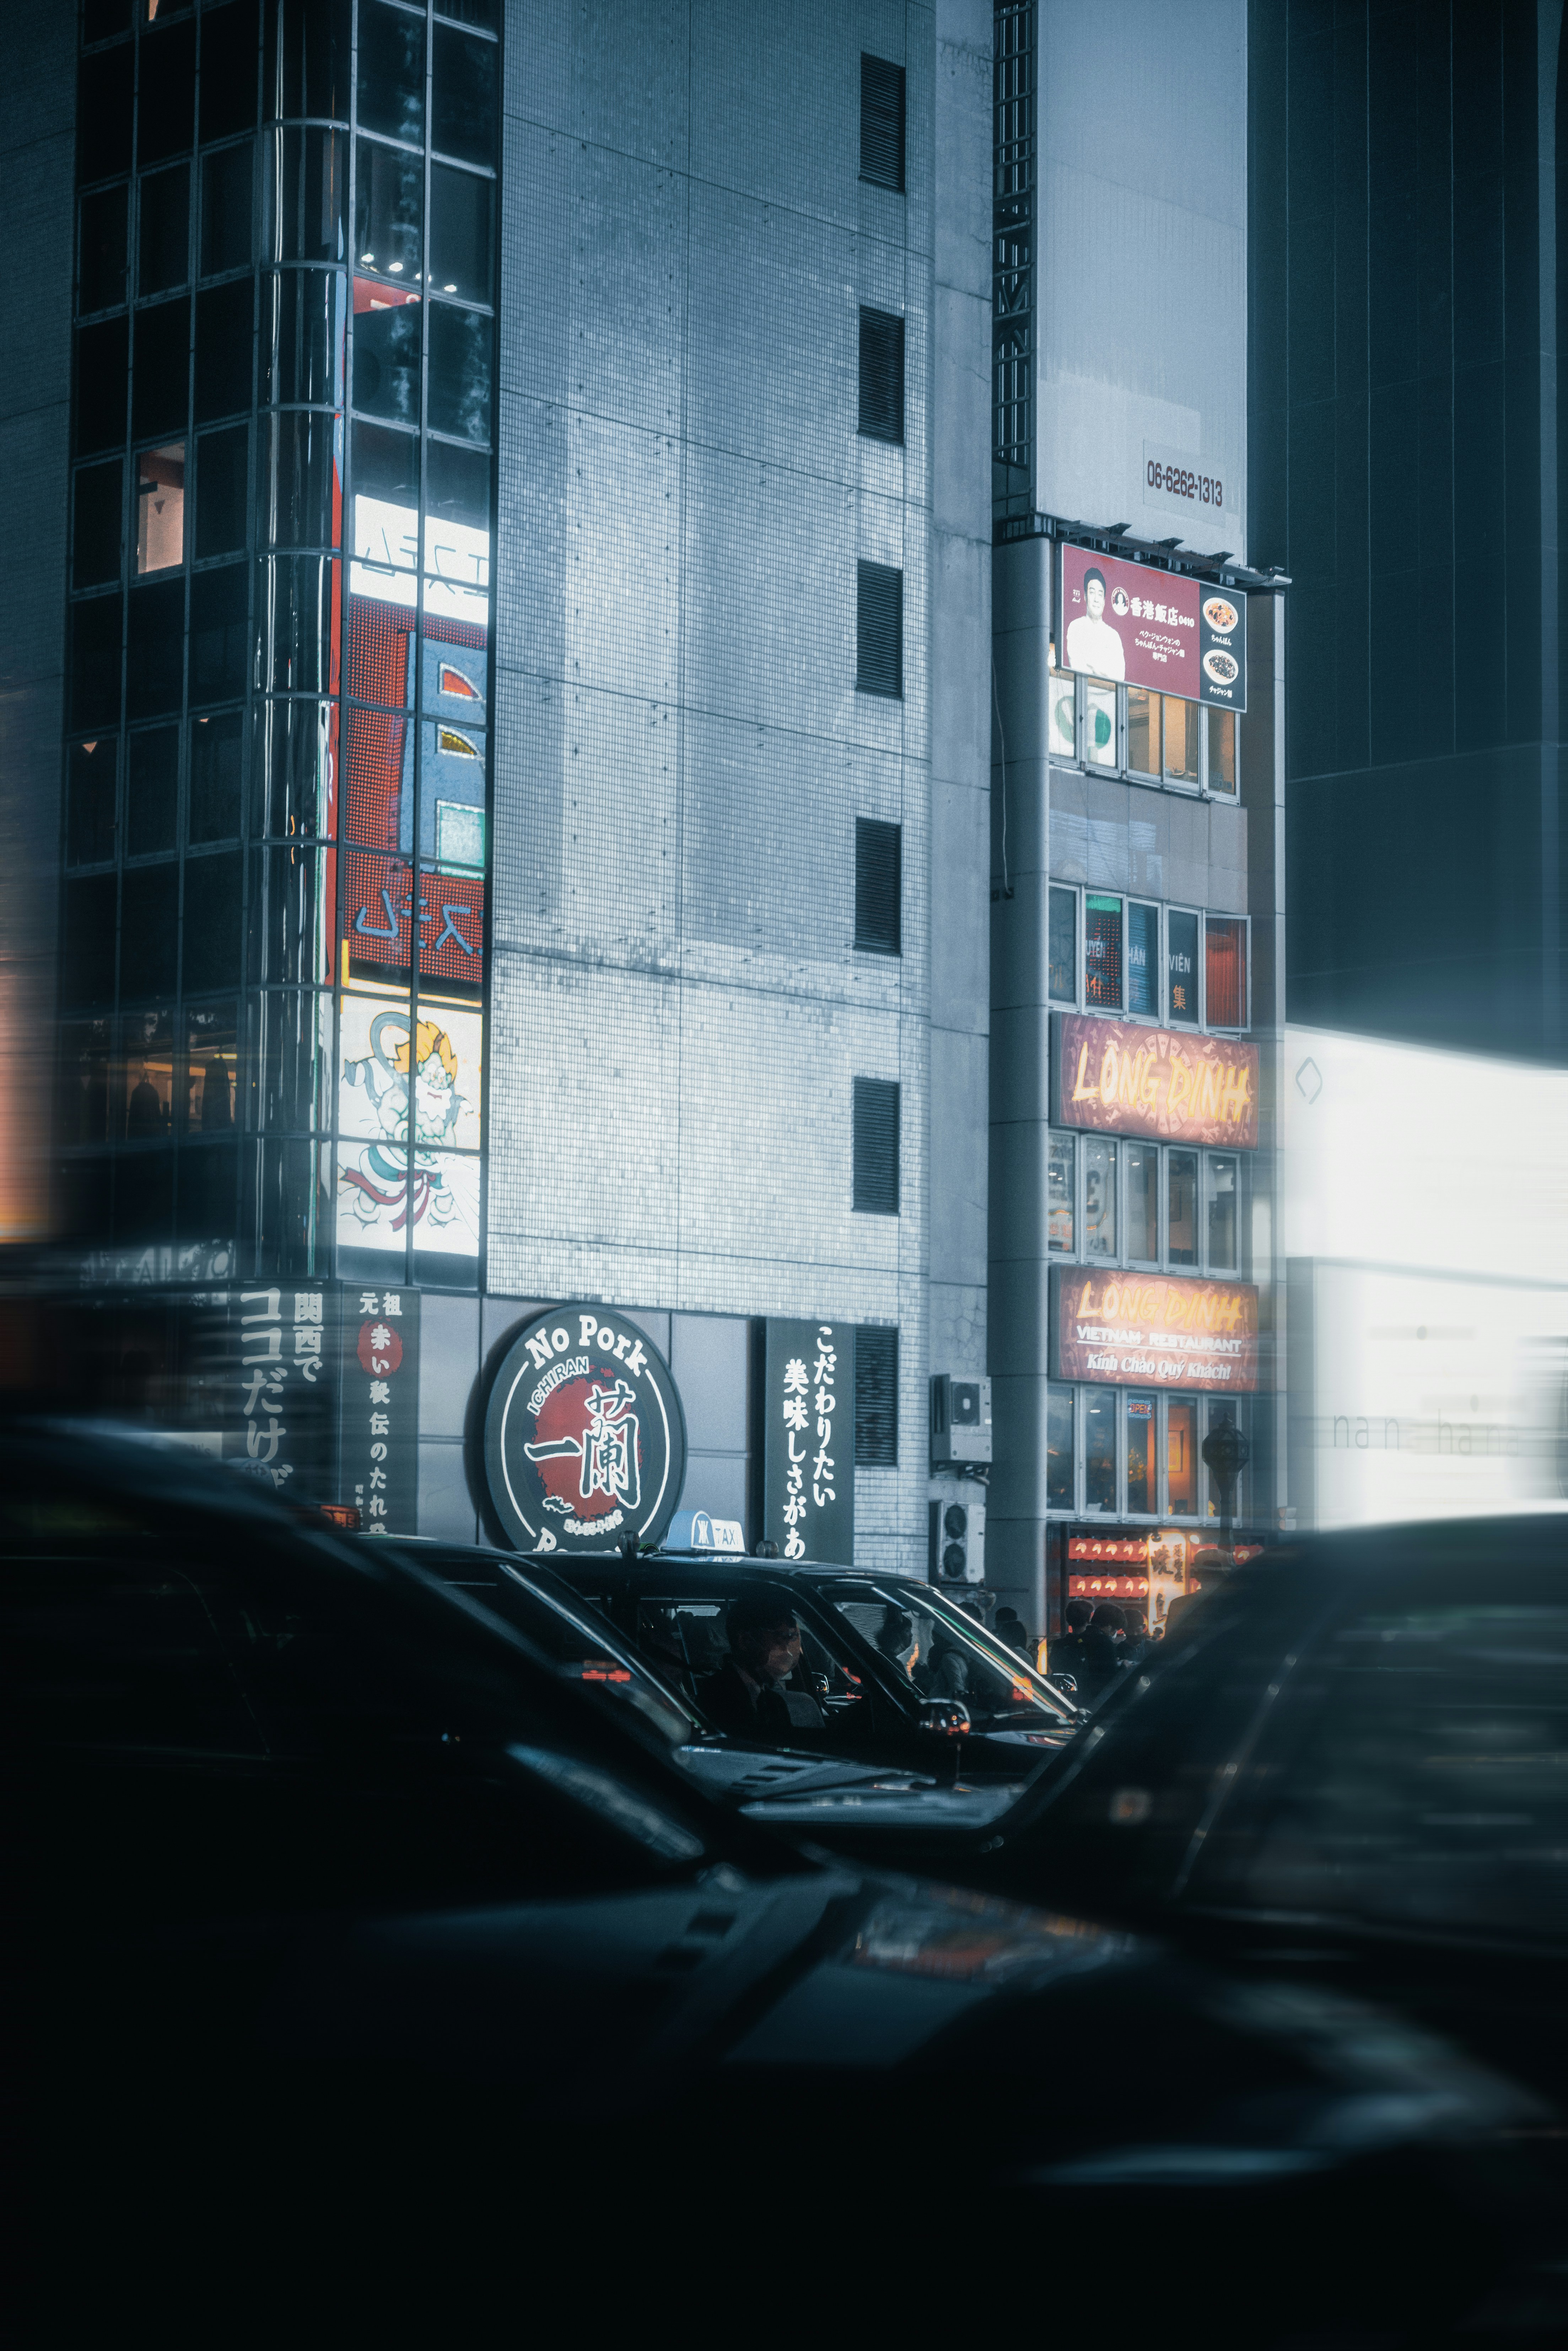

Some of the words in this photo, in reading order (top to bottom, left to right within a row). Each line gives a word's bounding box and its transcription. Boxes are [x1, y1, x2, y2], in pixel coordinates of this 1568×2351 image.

[1147, 460, 1223, 507] 06-6262-1313
[1072, 1042, 1161, 1112] LONG
[1166, 1055, 1250, 1123] DINH
[359, 1292, 402, 1316] 元祖
[1076, 1281, 1160, 1324] LONG
[1164, 1289, 1243, 1331] DINH
[293, 1293, 324, 1382] 関西で
[524, 1327, 570, 1370] No
[579, 1315, 647, 1377] Pork
[1077, 1325, 1141, 1344] VIETNAM
[1149, 1332, 1242, 1353] RESTAURANT
[1087, 1353, 1118, 1371] Kính
[1121, 1356, 1155, 1374] Chào
[1158, 1359, 1185, 1379] Quý
[1187, 1362, 1232, 1380] Khách!
[527, 1356, 589, 1416] ICHIRAN
[524, 1379, 640, 1509] 一蘭
[813, 1326, 837, 1507] こだわりたい
[783, 1359, 809, 1560] 美味しさがあ
[715, 1528, 738, 1545] TAXI
